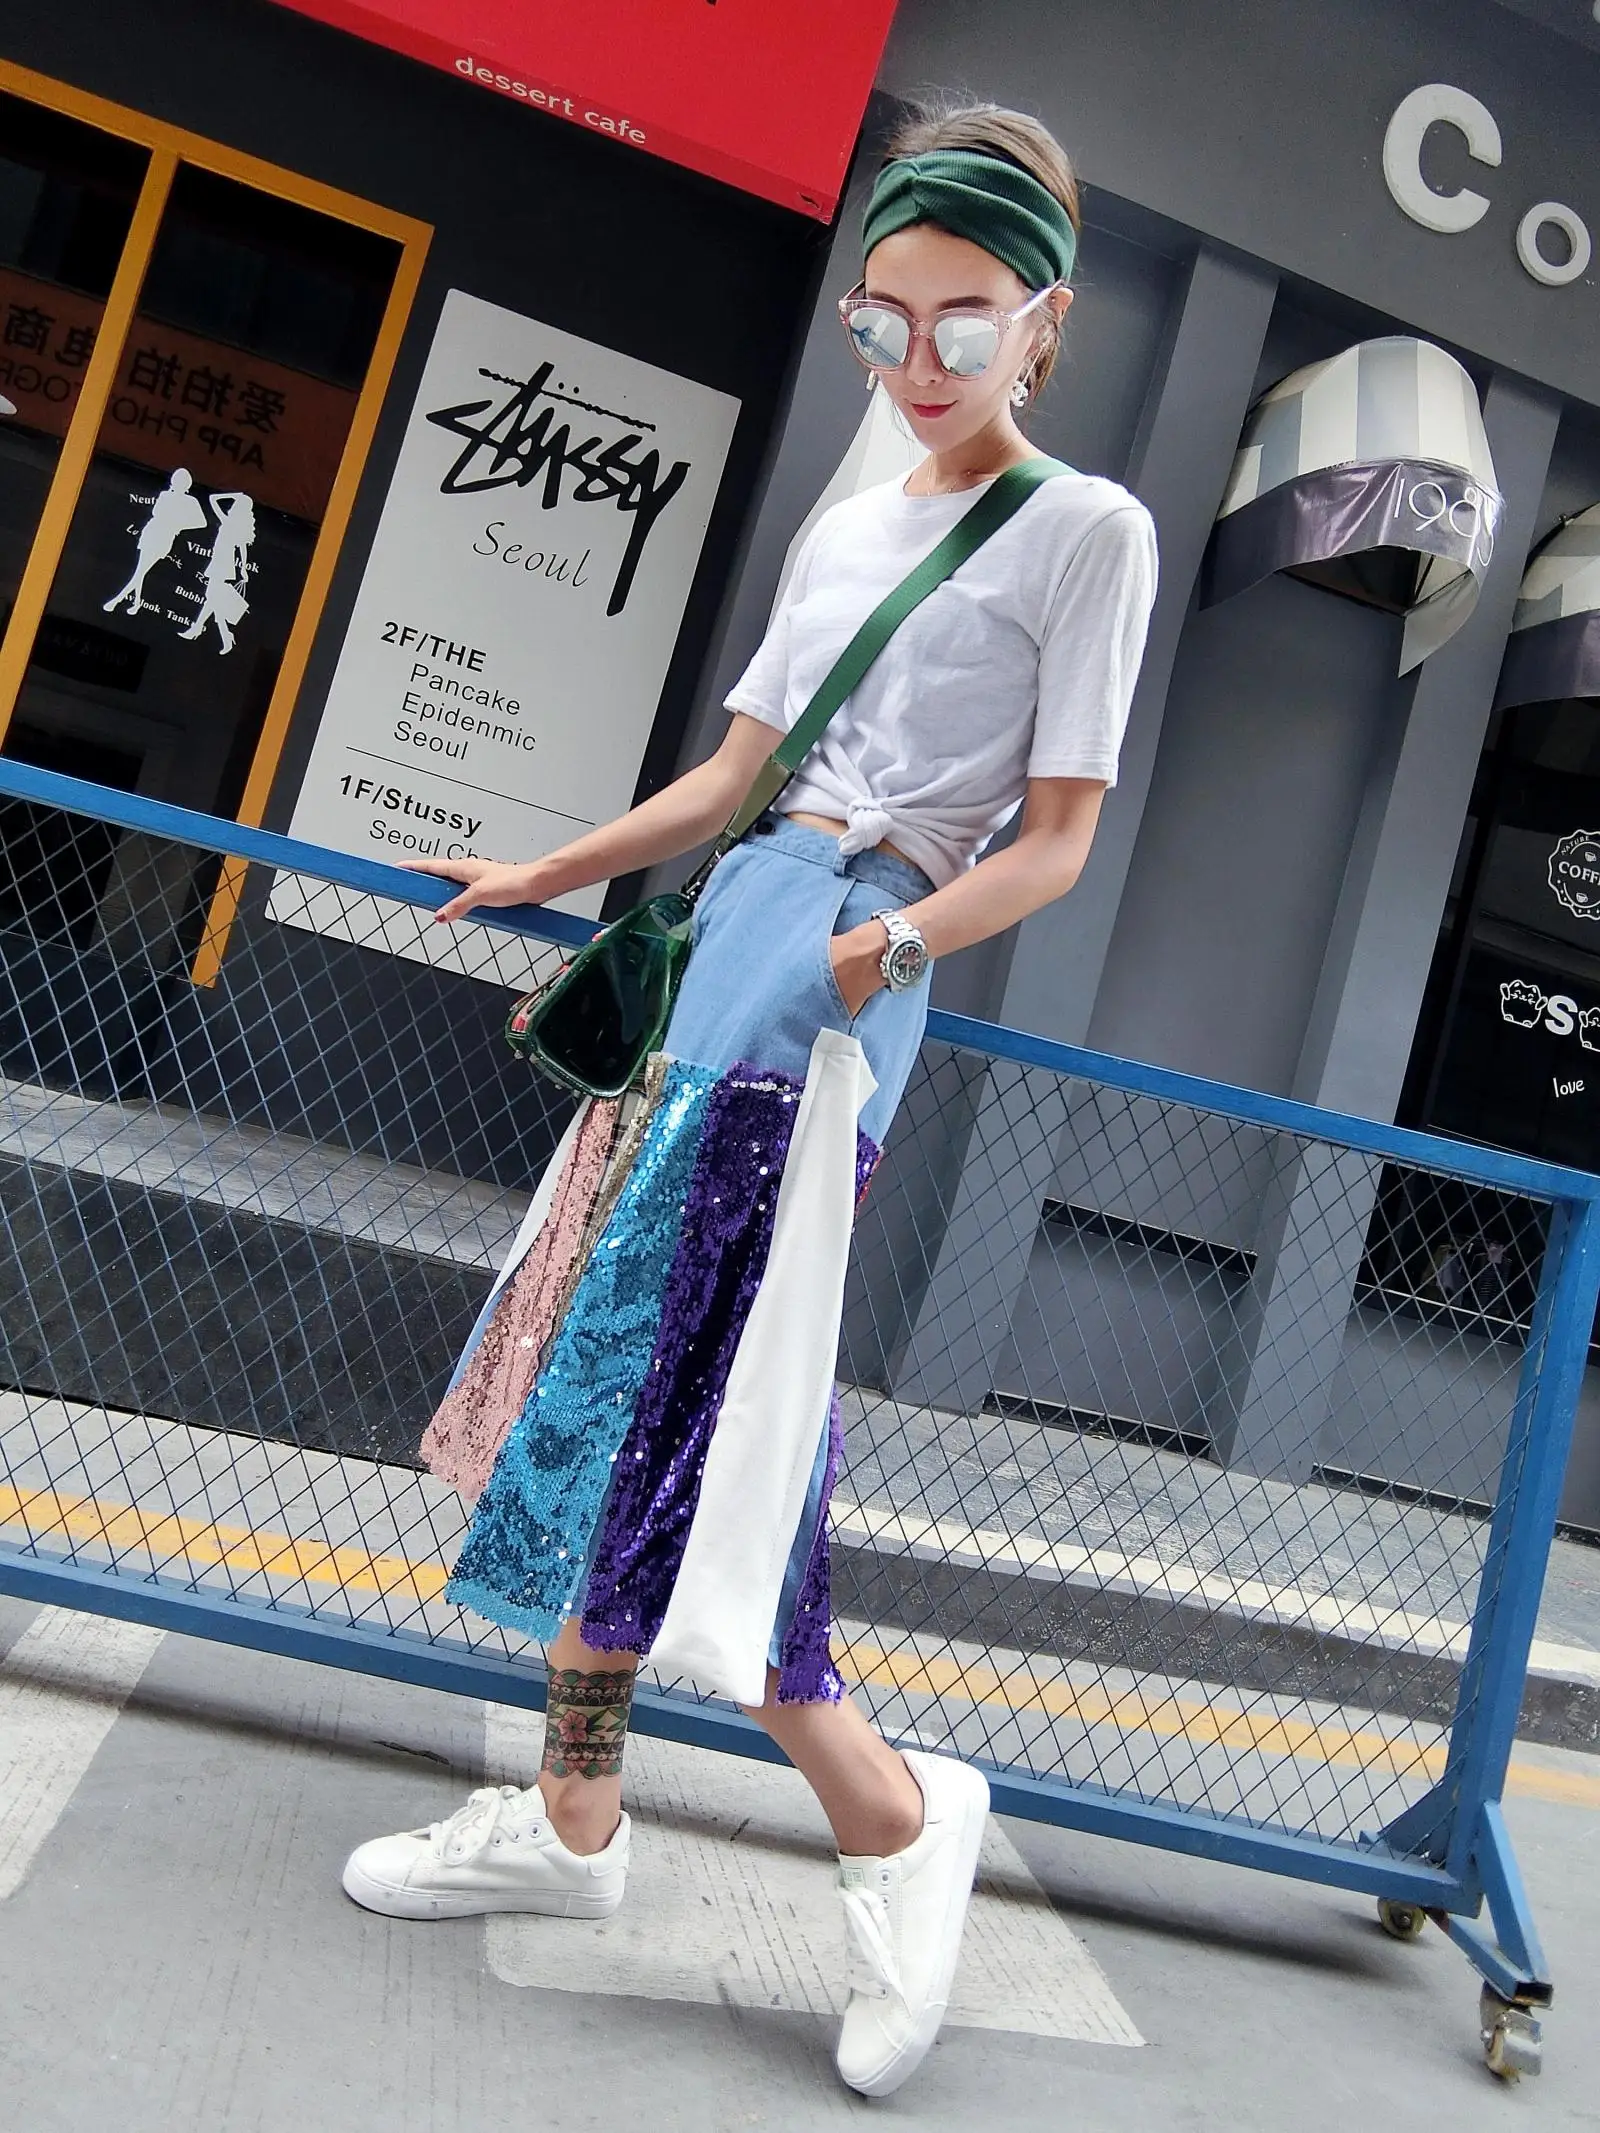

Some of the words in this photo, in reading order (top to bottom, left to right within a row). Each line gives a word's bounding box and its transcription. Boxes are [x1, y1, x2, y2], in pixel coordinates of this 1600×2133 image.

[455, 56, 575, 117] dessert
[584, 110, 646, 145] cafe
[129, 493, 156, 505] Neut
[186, 541, 215, 558] Vint
[472, 521, 591, 587] Seoul
[174, 585, 207, 606] Bubbl
[380, 621, 487, 673] 2F/THE
[409, 663, 521, 716] Pancake
[393, 720, 469, 760] Seoul
[401, 691, 537, 752] Epidenmic
[339, 774, 483, 838] 1F/Stussy
[369, 819, 441, 857] Seoul
[1553, 1077, 1585, 1098] love
